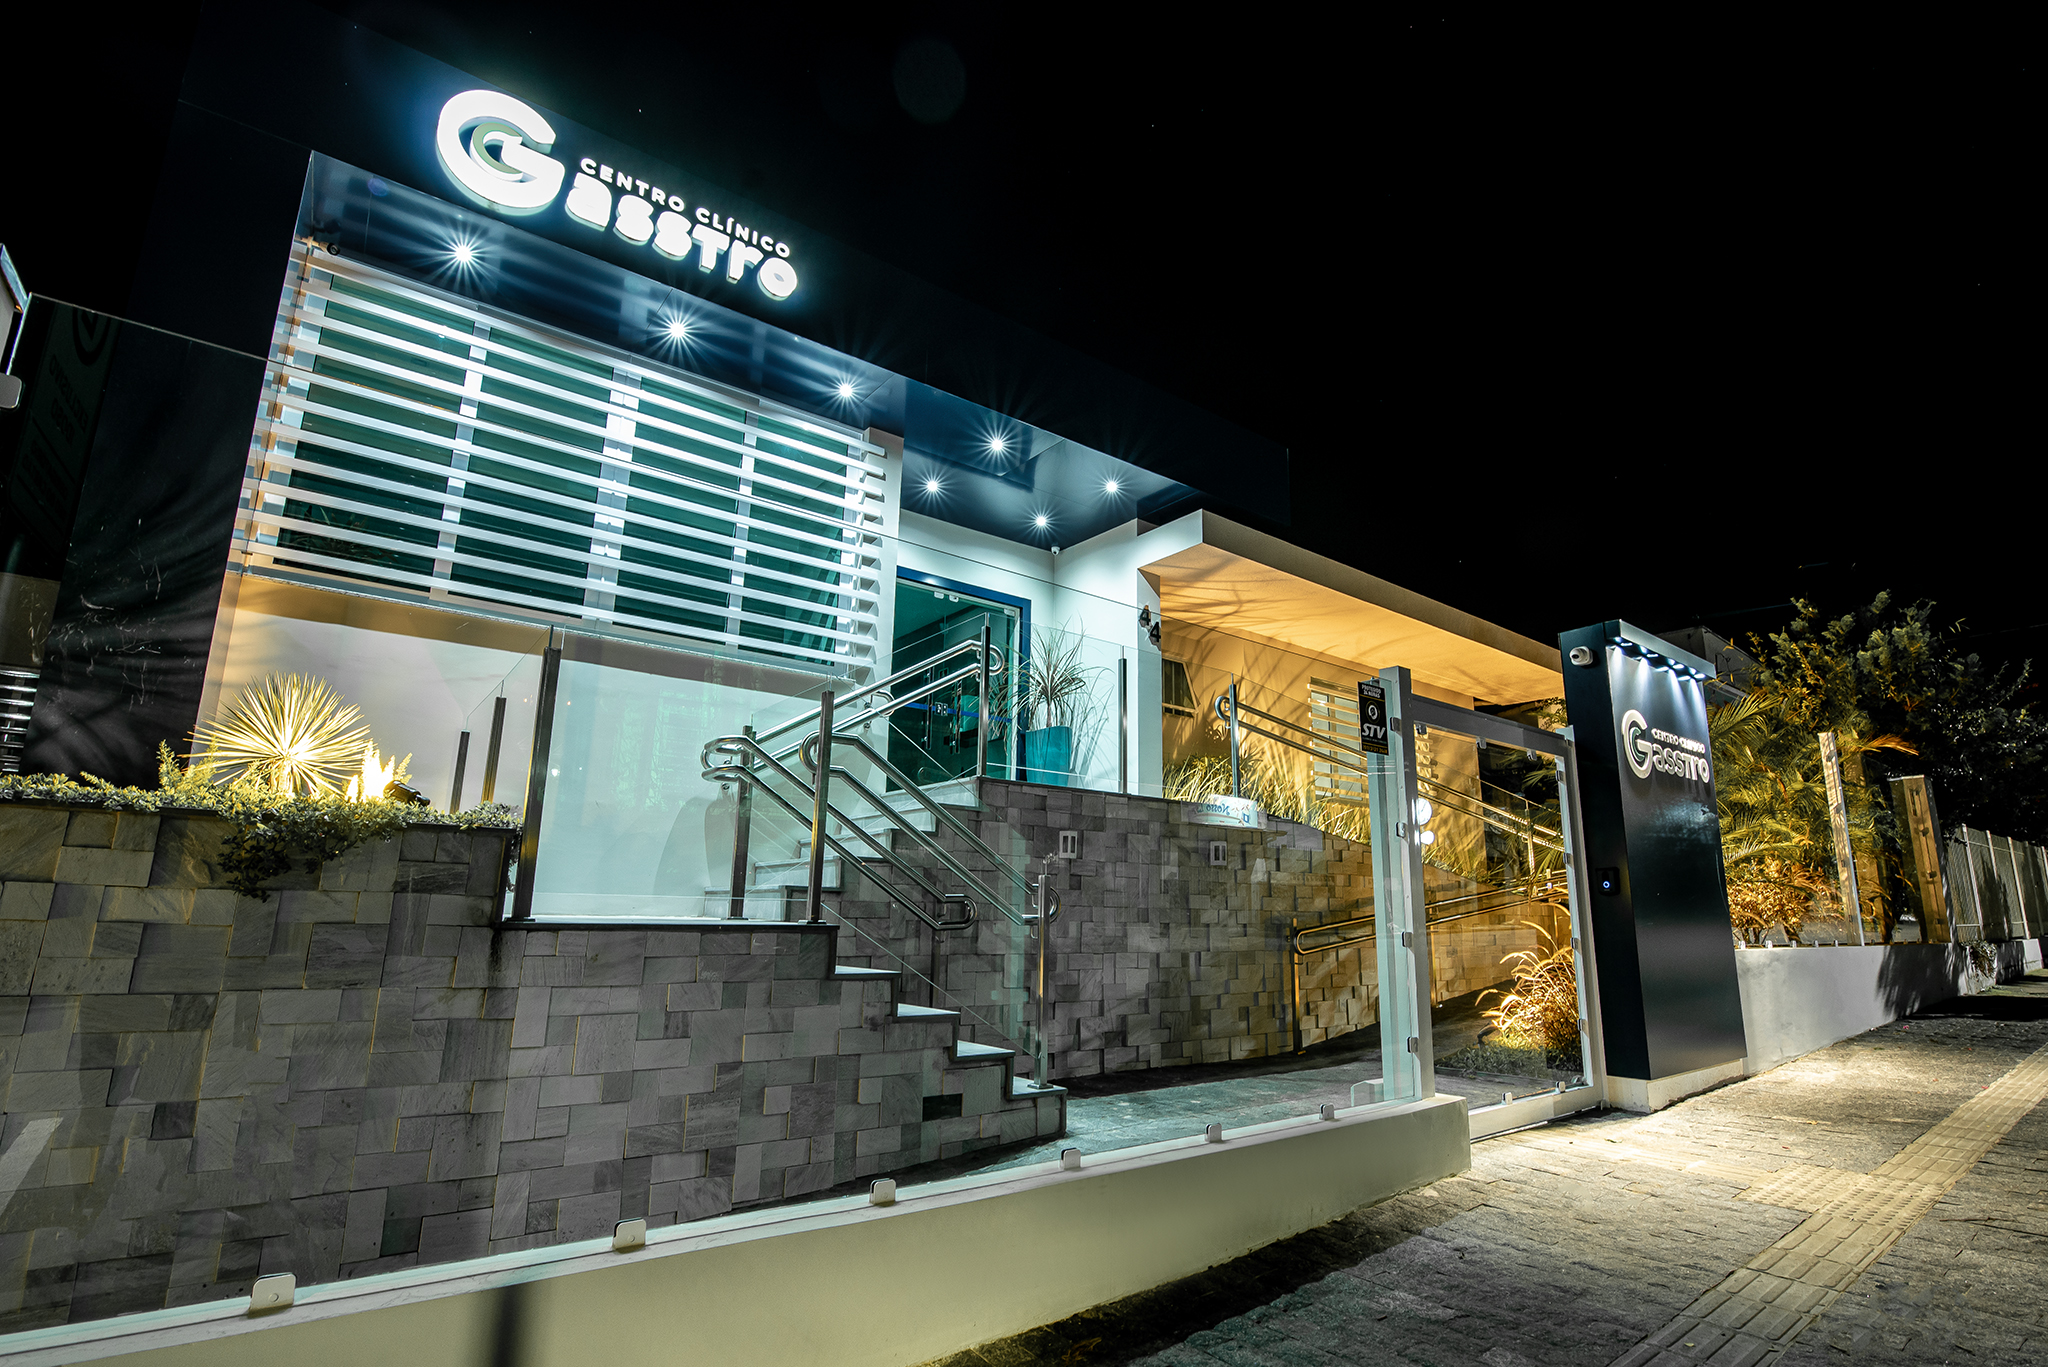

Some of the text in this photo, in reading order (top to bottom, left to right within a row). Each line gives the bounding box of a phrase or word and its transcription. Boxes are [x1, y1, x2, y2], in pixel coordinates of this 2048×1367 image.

[579, 157, 791, 258] CENTRO CLÍNICO
[1362, 723, 1386, 738] STV
[1651, 728, 1679, 745] CENTRO
